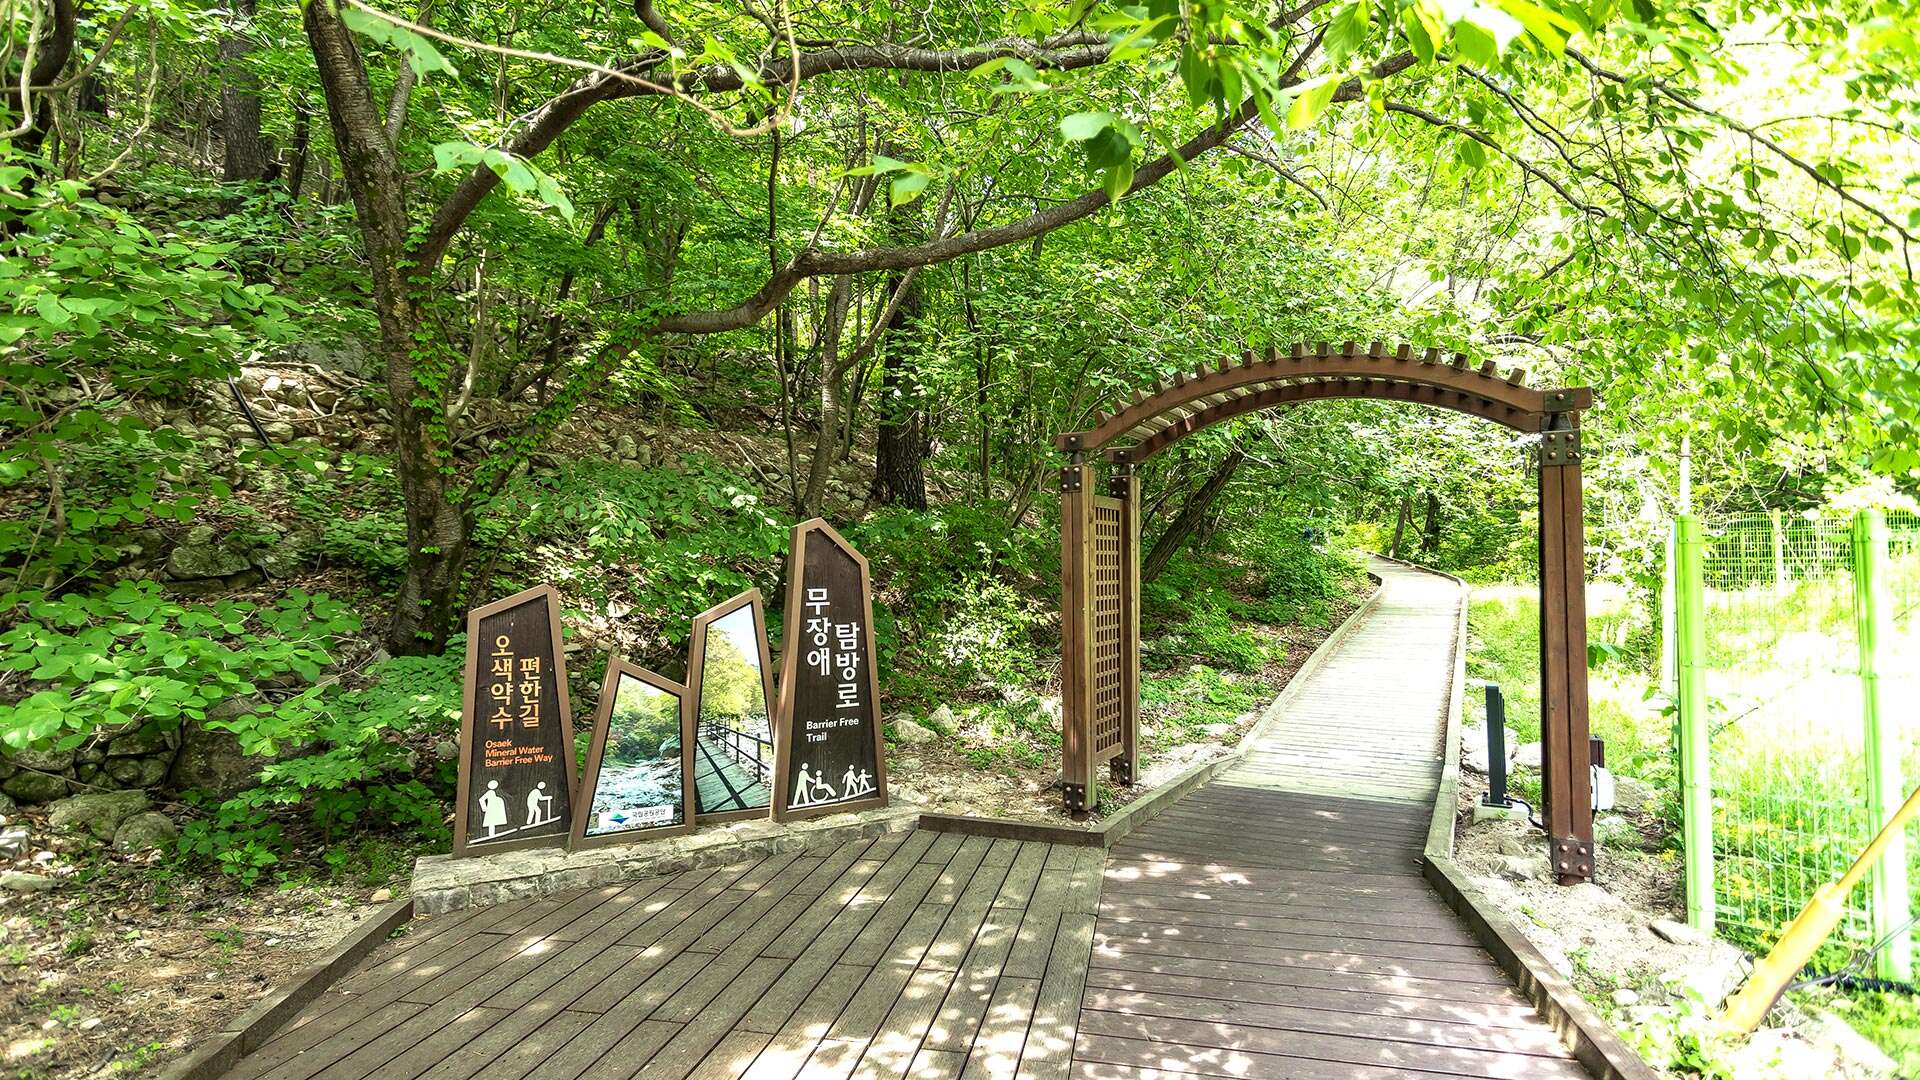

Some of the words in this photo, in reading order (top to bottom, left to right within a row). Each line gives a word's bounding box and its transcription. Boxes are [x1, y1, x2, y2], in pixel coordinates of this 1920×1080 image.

[806, 588, 831, 676] 무장애
[835, 622, 860, 709] 탐방로
[490, 635, 514, 730] 오색약수
[518, 656, 542, 729] 편한길
[806, 719, 838, 730] Barrier
[839, 717, 860, 727] Free
[485, 739, 512, 749] Osaek
[806, 732, 827, 743] Trail
[485, 747, 517, 758] Mineral
[518, 745, 544, 756] Water
[485, 757, 514, 768] Barrier
[514, 755, 533, 765] Free
[533, 754, 553, 764] Way
